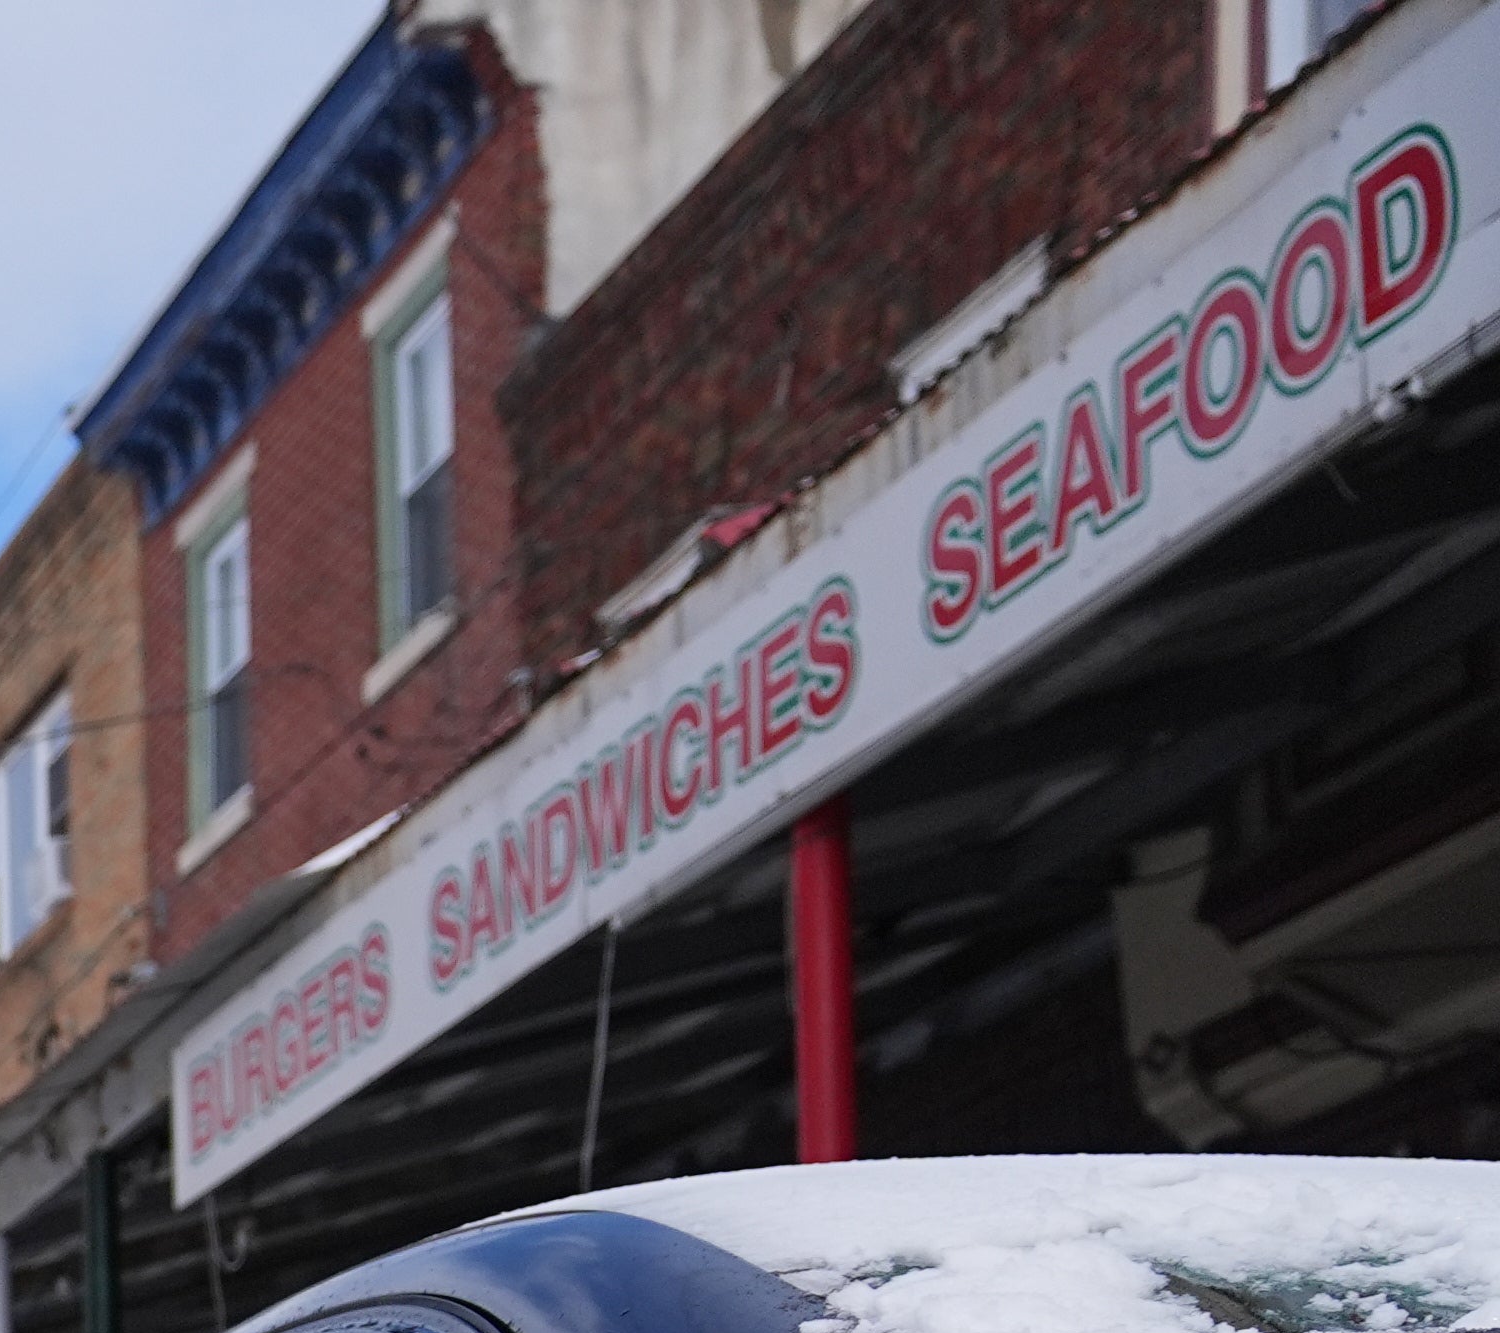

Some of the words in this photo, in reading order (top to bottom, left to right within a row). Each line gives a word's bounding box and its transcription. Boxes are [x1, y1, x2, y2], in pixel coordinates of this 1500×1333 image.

[187, 922, 391, 1166] BURGERS
[429, 575, 858, 995] SANDWICHES
[925, 123, 1460, 645] SEAFOOD
